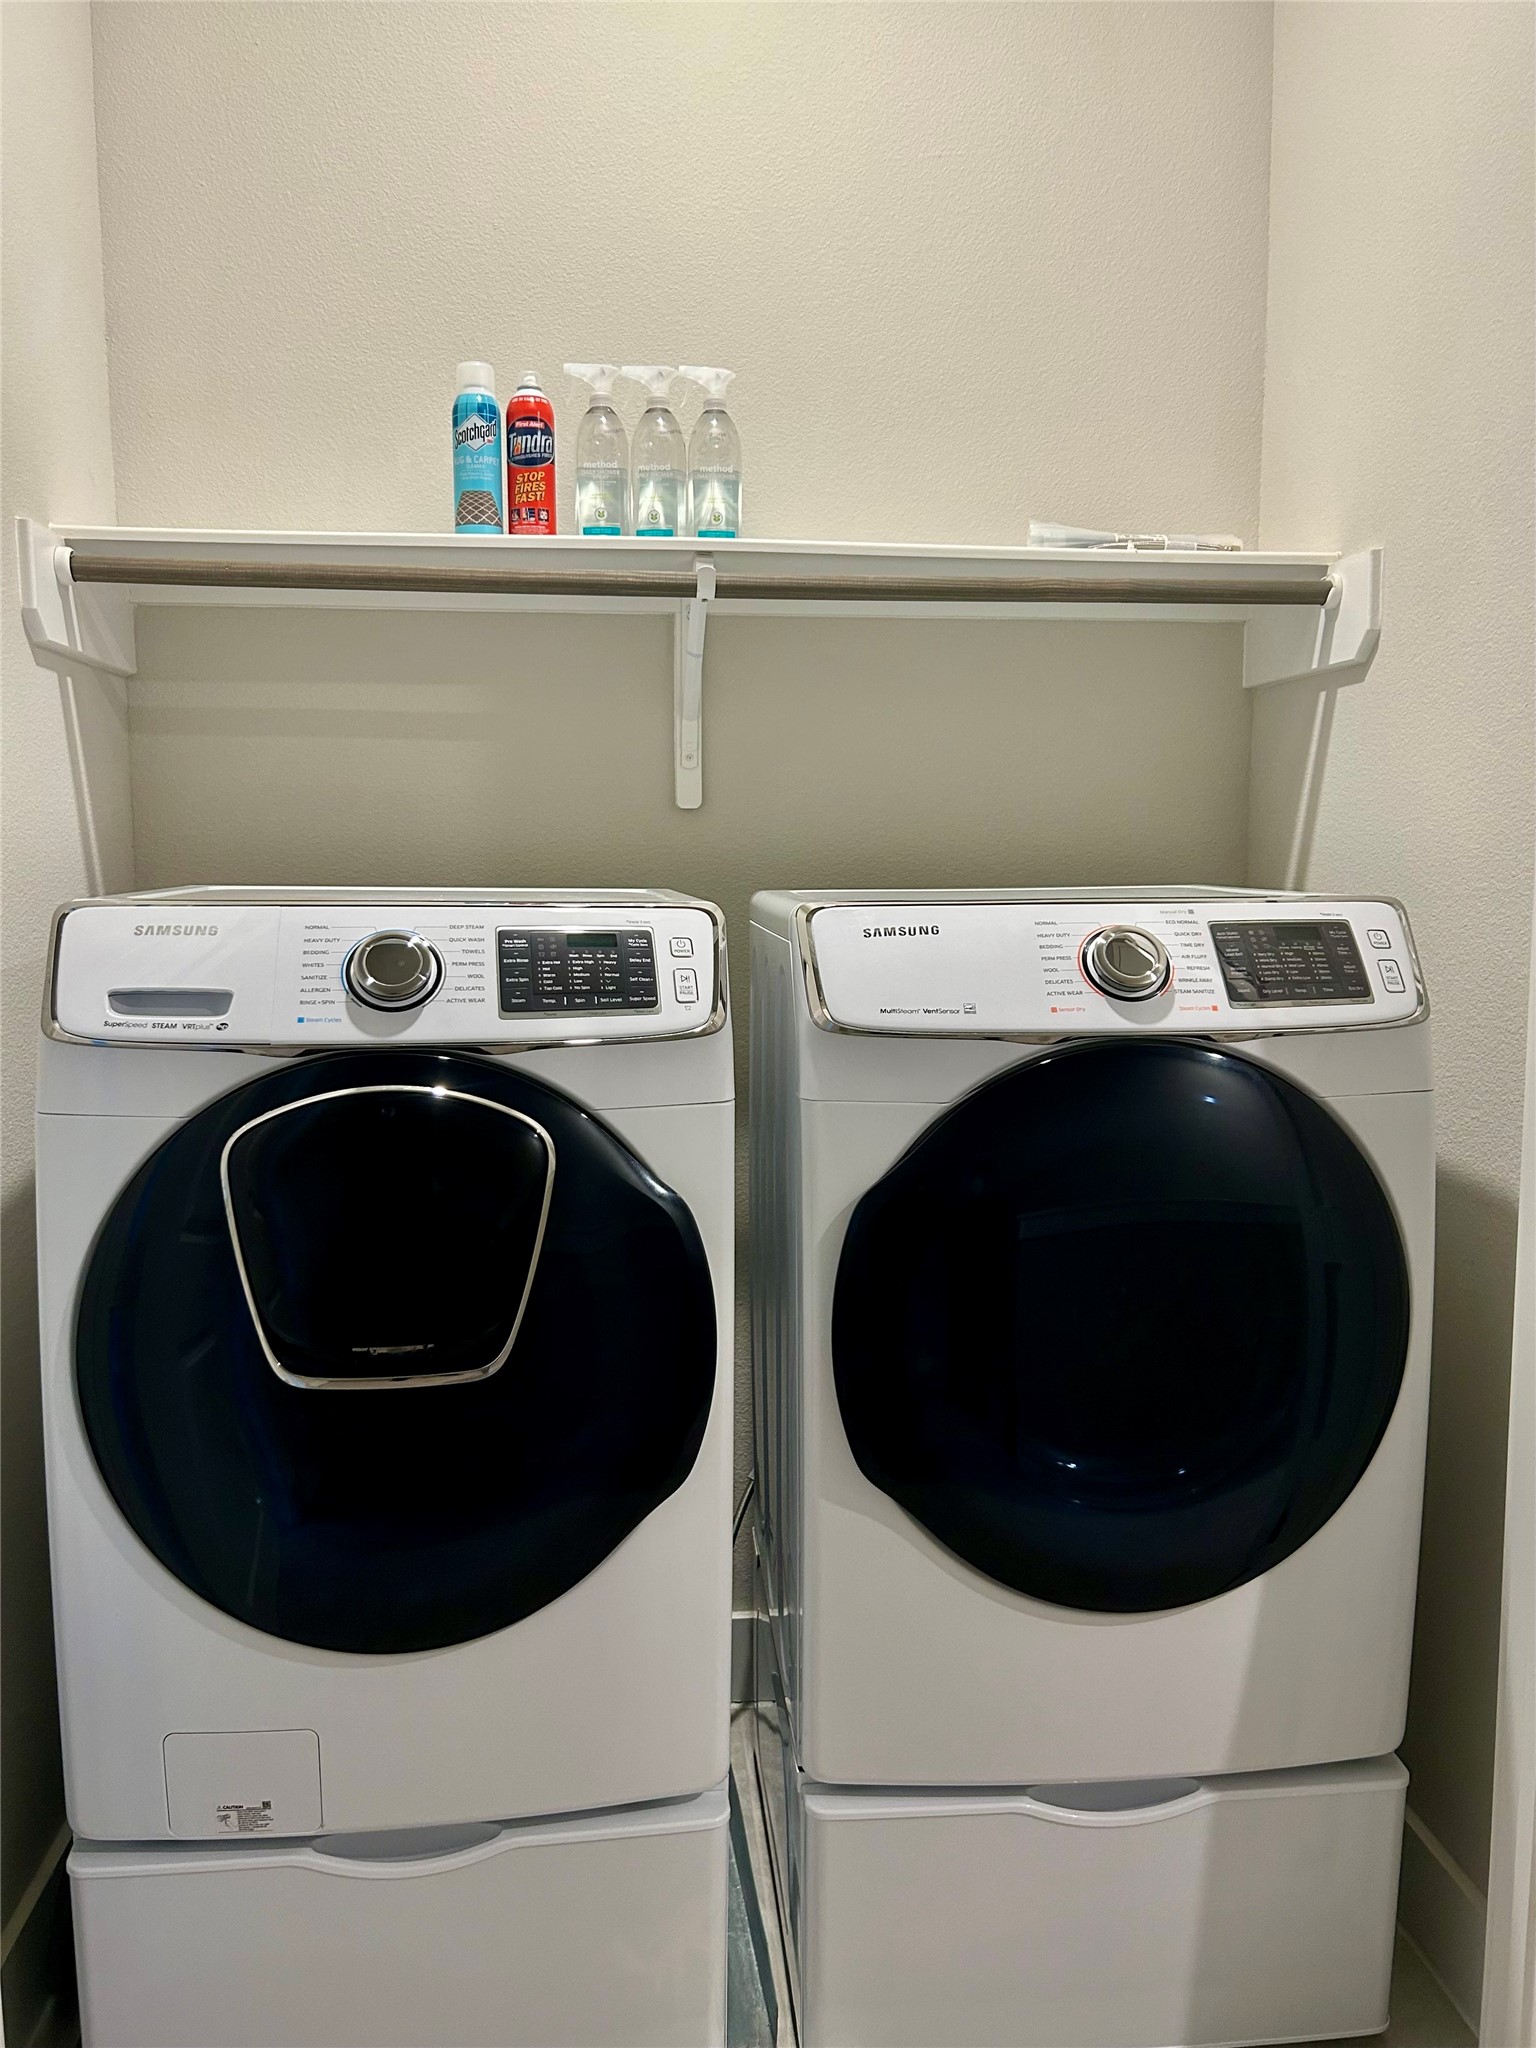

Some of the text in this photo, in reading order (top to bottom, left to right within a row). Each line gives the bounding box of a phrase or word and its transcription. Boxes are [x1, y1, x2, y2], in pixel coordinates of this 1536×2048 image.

[455, 419, 497, 450] Scotchgard
[509, 431, 553, 458] Tundra
[583, 460, 618, 468] method
[637, 463, 671, 471] method
[700, 464, 734, 473] method
[516, 471, 545, 483] STOP
[514, 482, 546, 495] FIRES
[515, 492, 545, 505] FAST!
[134, 925, 219, 936] SAMSUNG
[863, 925, 940, 938] SAMSUNG
[103, 1020, 148, 1029] SuperSpeed
